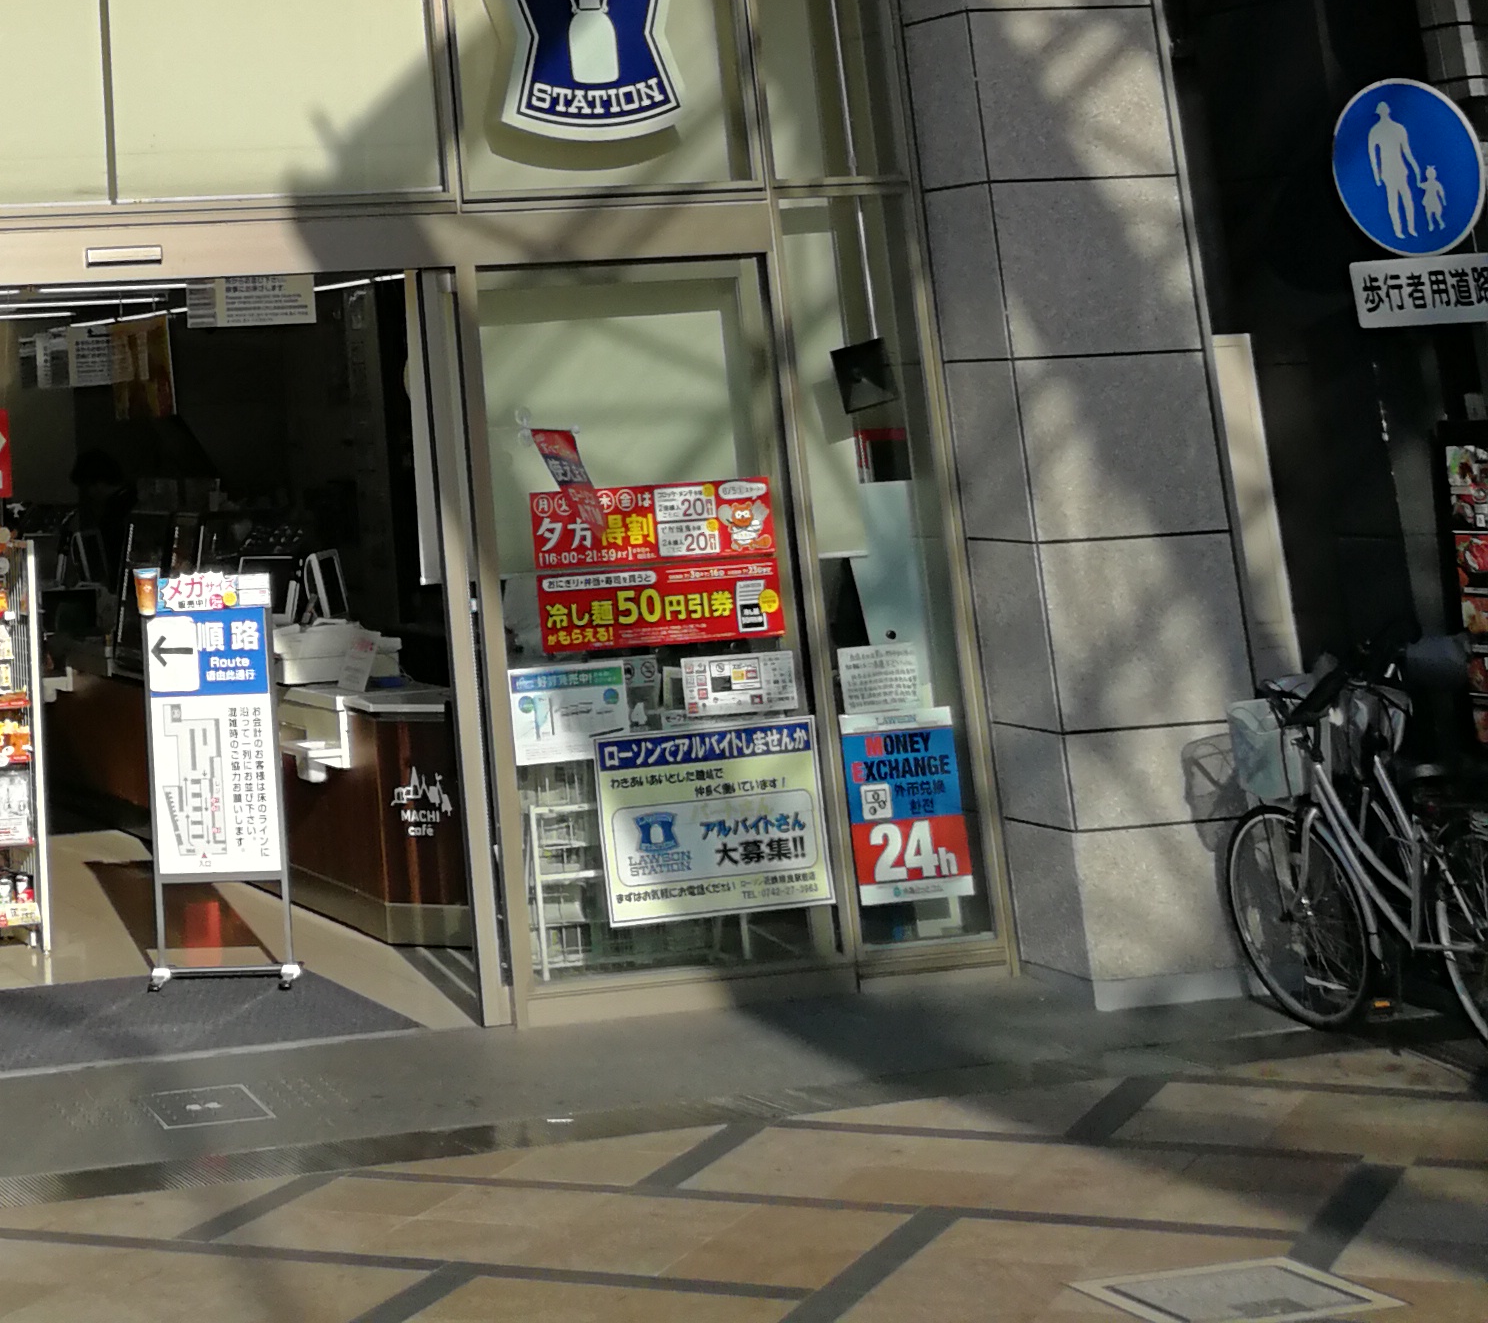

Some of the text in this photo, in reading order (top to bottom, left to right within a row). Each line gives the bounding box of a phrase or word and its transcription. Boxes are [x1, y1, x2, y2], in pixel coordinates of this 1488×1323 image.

[531, 77, 665, 115] STATION
[1362, 266, 1488, 313] 歩行者用道路
[167, 575, 235, 601] メガサイズ
[545, 588, 734, 629] 冷し麺50円引券
[196, 620, 260, 652] 順路
[547, 626, 614, 645] がもらえる!
[210, 656, 251, 668] Route
[604, 727, 808, 767] ローソンでアルバイトしませんか
[864, 731, 931, 757] MONEY
[851, 754, 951, 783] EXCHANGE
[400, 809, 440, 823] MACHI
[699, 810, 806, 841] アルバイトさん
[628, 850, 693, 867] LAWSON
[715, 835, 807, 867] 大募集!!
[869, 819, 958, 883] 24h
[630, 861, 693, 877] STATION
